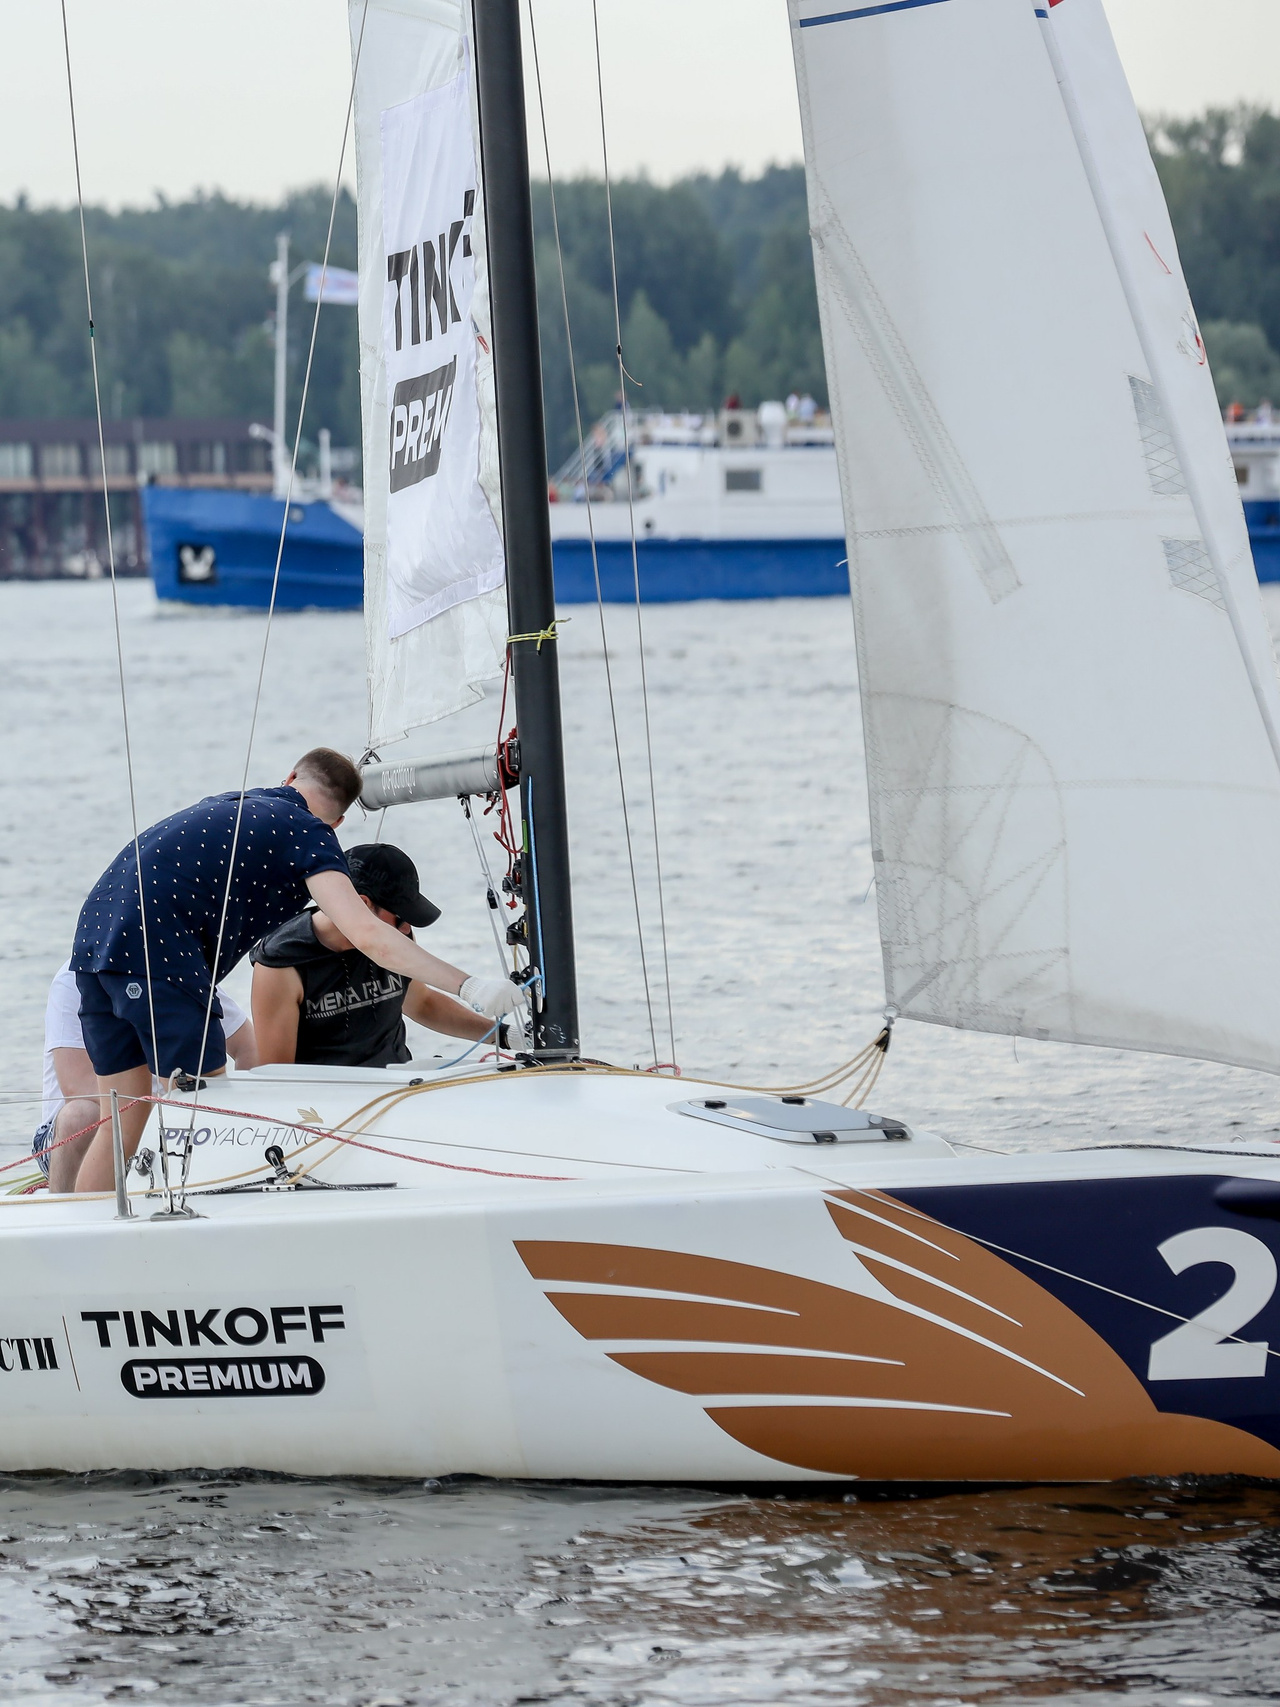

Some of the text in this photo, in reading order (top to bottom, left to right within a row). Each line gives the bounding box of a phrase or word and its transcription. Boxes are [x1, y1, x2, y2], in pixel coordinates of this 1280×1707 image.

[388, 190, 475, 351] TINK
[80, 1304, 346, 1348] TINKOFF
[1147, 1226, 1278, 1381] 2
[131, 1361, 314, 1392] PREMIUM
